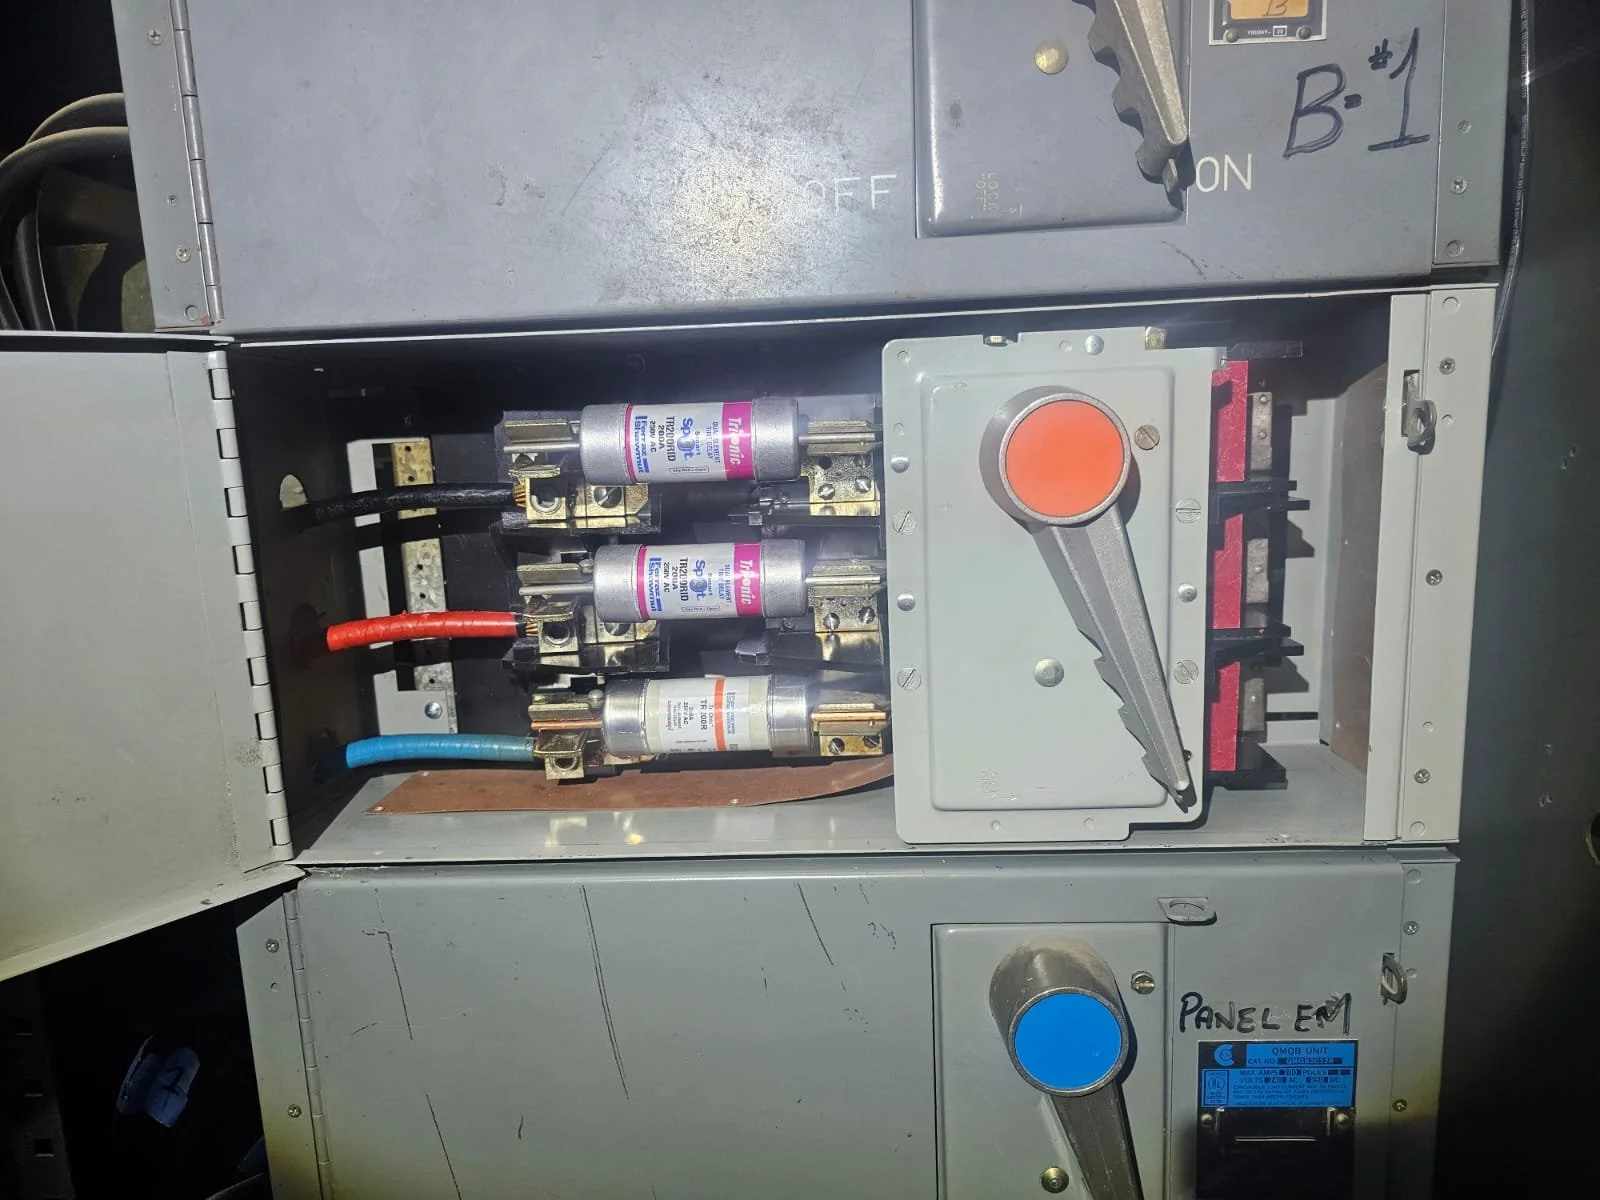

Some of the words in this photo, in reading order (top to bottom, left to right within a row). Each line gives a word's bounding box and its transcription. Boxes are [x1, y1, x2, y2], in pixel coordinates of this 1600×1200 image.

[1195, 152, 1252, 193] ON
[802, 173, 898, 217] OFF
[635, 420, 644, 473] Shawmut
[640, 420, 648, 458] Ferraz
[650, 441, 657, 453] AC
[666, 416, 677, 462] TR200RID
[648, 562, 657, 612] Shawmut
[664, 582, 670, 593] AC
[679, 557, 689, 602] TR200RID
[1179, 991, 1280, 1033] PANEL
[1305, 1046, 1329, 1055] UNIT
